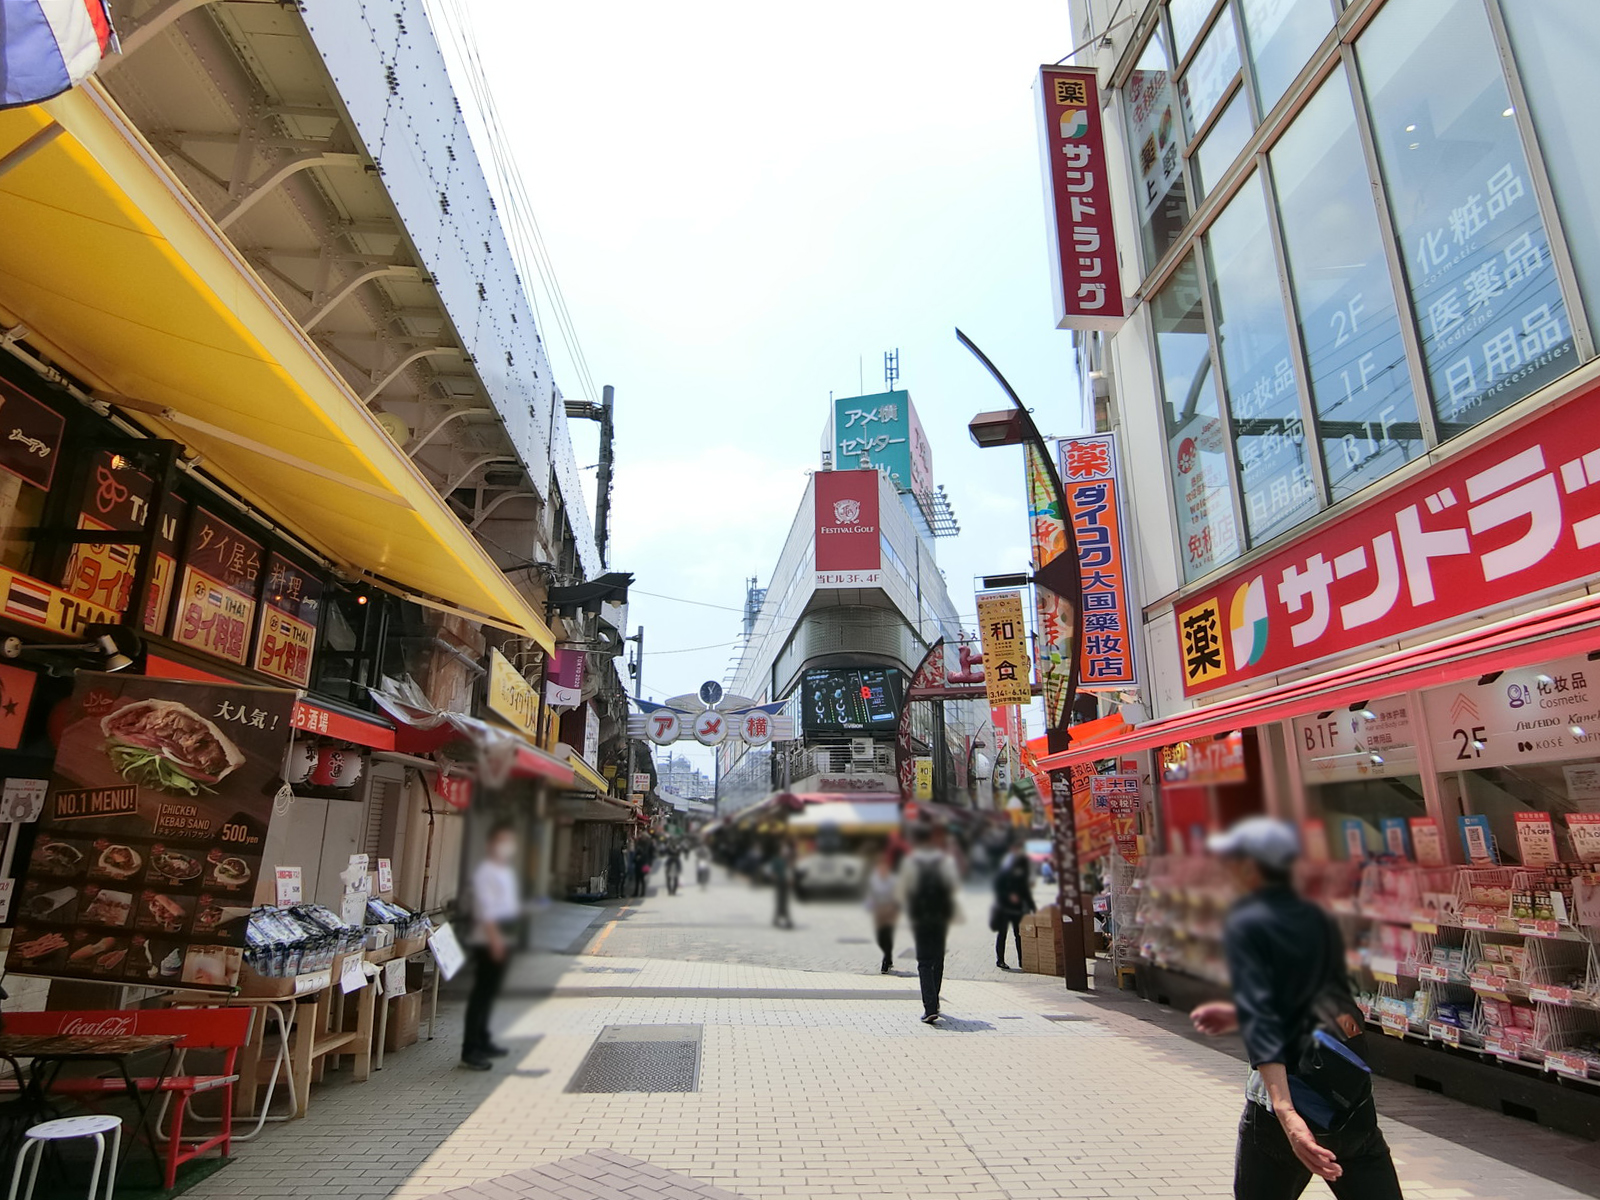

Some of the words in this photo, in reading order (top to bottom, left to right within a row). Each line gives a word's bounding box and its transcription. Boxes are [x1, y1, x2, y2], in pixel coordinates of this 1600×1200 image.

[1058, 81, 1085, 104] 薬
[1062, 143, 1106, 310] サンドラッグ
[1416, 162, 1525, 275] 化粧品
[1423, 241, 1477, 289] Cosmetic
[1427, 231, 1544, 341] 医薬品
[1329, 292, 1367, 349] 2F
[1436, 309, 1494, 353] Medicine
[1444, 303, 1564, 405] 日用品
[1339, 351, 1378, 403] 1F
[1450, 391, 1484, 420] Daily
[1487, 342, 1570, 398] necessities
[844, 403, 898, 429] アメ横
[839, 434, 905, 456] センター
[1341, 404, 1400, 470] B1F
[1066, 440, 1112, 479] 薬
[821, 526, 853, 534] FESTIVAL
[854, 525, 875, 533] GOLF
[196, 524, 261, 582] タイ屋台
[269, 561, 303, 603] 料理
[225, 595, 246, 618] THAI
[183, 602, 245, 659] タイ料理
[293, 626, 309, 645] THAI
[1183, 606, 1222, 680] 薬
[262, 633, 307, 680] タイ料理
[576, 655, 584, 674] TOKYO
[573, 674, 581, 688] 2020
[1537, 671, 1587, 696] 化妆品
[1539, 692, 1589, 709] Cosmetic
[654, 717, 768, 738] アメ横
[1304, 722, 1339, 751] B1F
[1515, 717, 1560, 732] SHISEIDO
[1453, 726, 1487, 760] 2F
[1536, 736, 1564, 750] KOSÉ
[57, 790, 87, 816] NO.1
[90, 787, 134, 812] MENU!
[161, 803, 198, 817] CHICKEN
[159, 815, 186, 828] KEBAB
[187, 819, 211, 831] SAND
[221, 822, 248, 843] 500
[247, 834, 259, 845] yen
